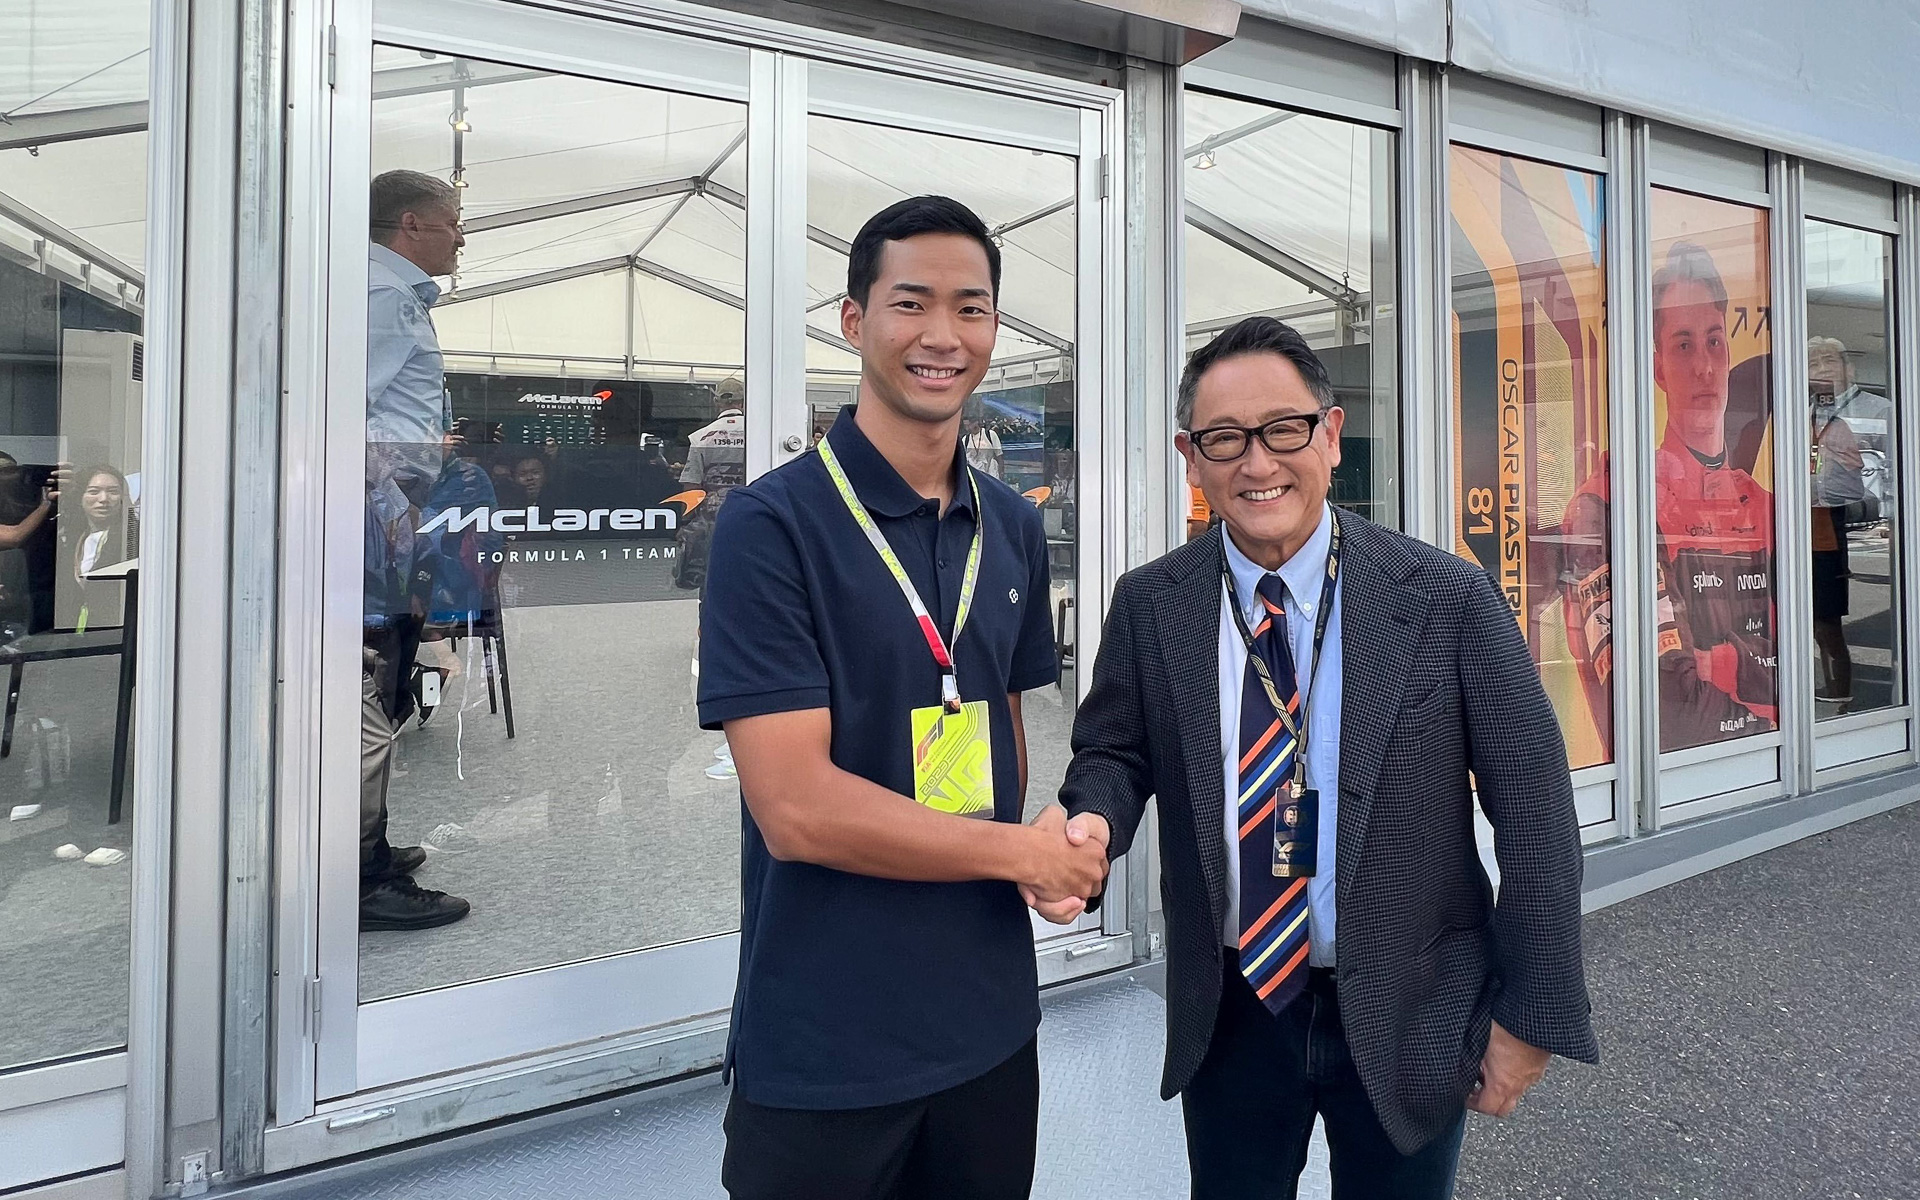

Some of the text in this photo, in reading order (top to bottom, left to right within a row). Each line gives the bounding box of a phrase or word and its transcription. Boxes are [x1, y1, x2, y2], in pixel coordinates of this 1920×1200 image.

[1502, 359, 1519, 474] OSCAR
[415, 506, 677, 534] McLaren
[1468, 487, 1494, 534] 81
[477, 547, 677, 564] FORMULA 1 TEAM
[880, 547, 906, 581] JAPAN
[919, 759, 950, 798] 2023
